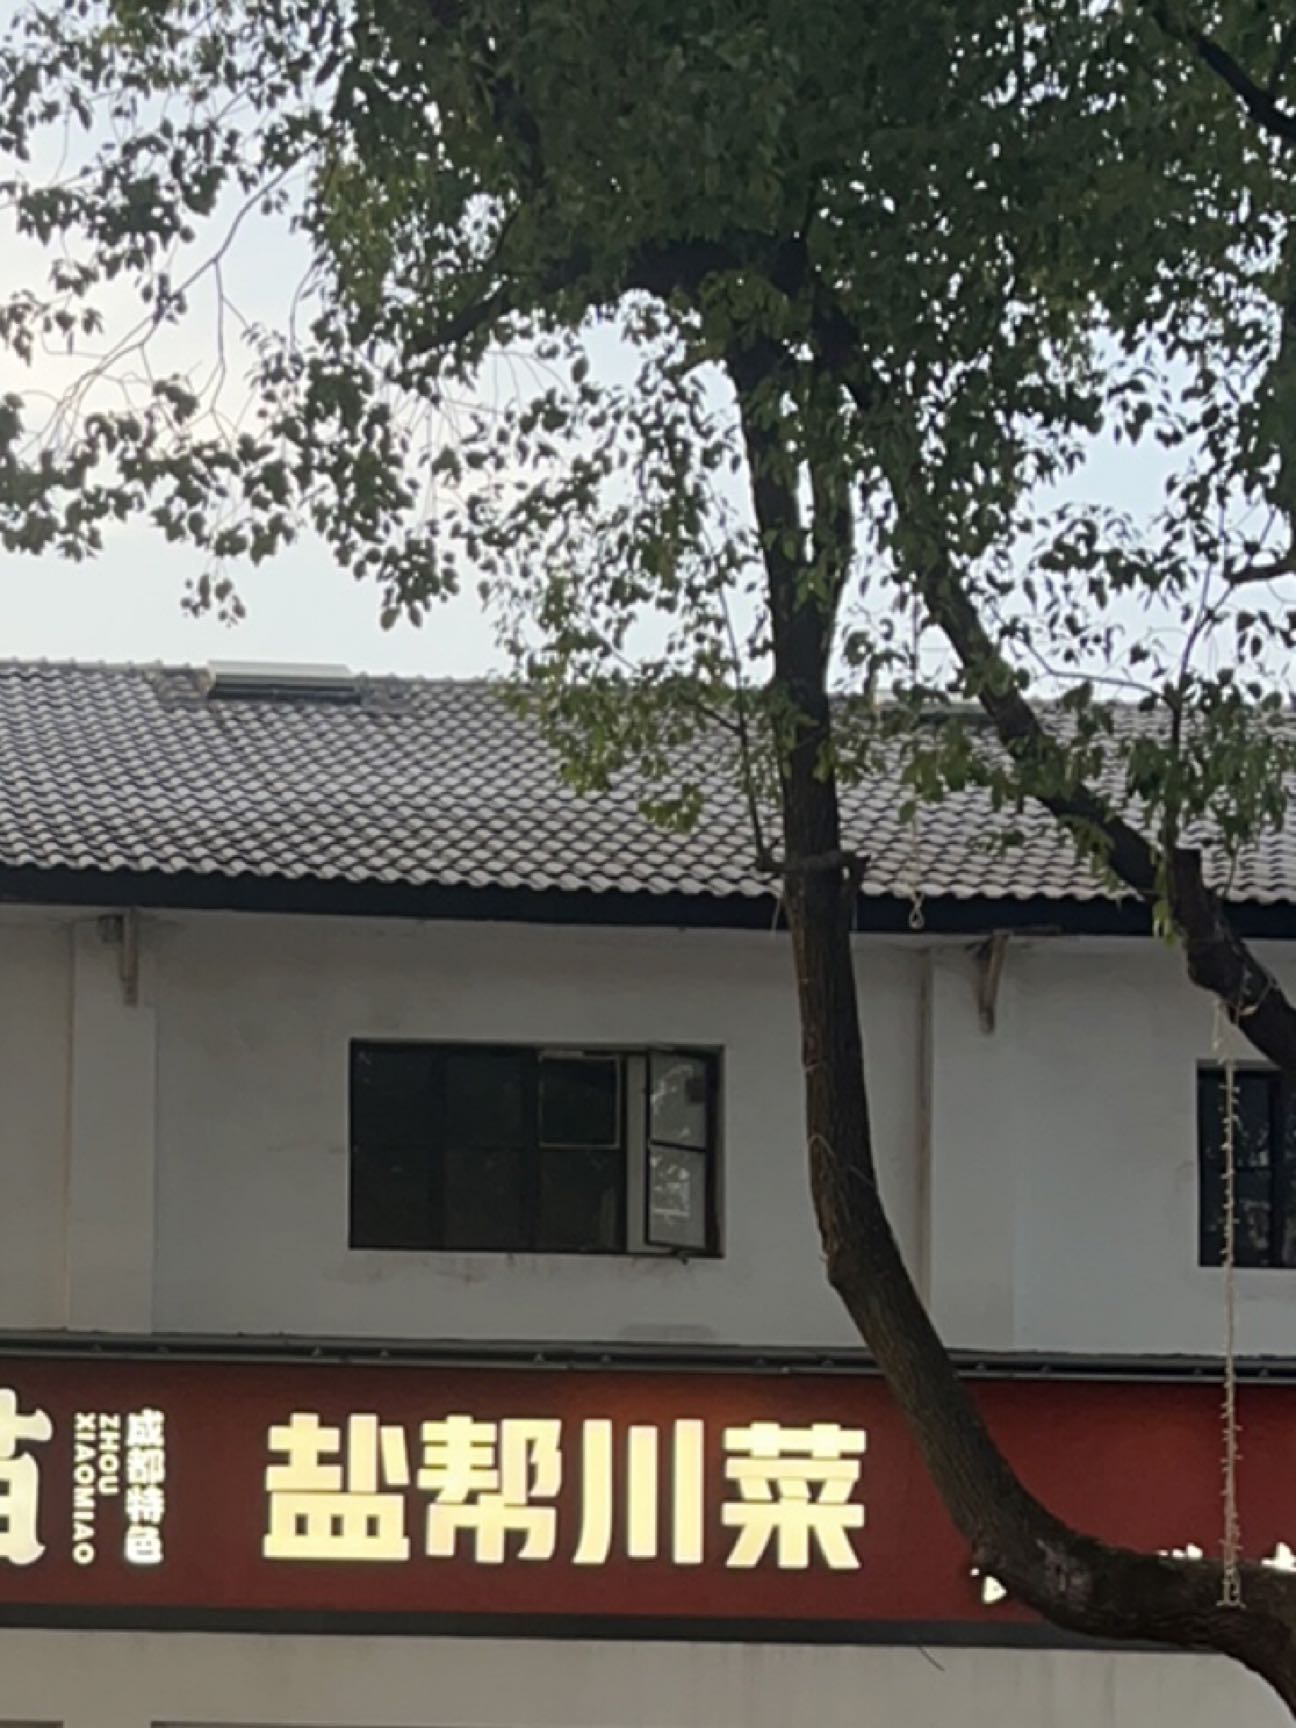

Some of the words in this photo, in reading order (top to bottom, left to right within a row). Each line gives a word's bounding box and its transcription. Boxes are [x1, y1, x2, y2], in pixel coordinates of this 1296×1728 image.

[72, 1412, 96, 1565] XIAOMIAO
[98, 1412, 121, 1495] ZHOU
[125, 1408, 166, 1565] 成都特色
[263, 1411, 868, 1569] 盐帮川菜
